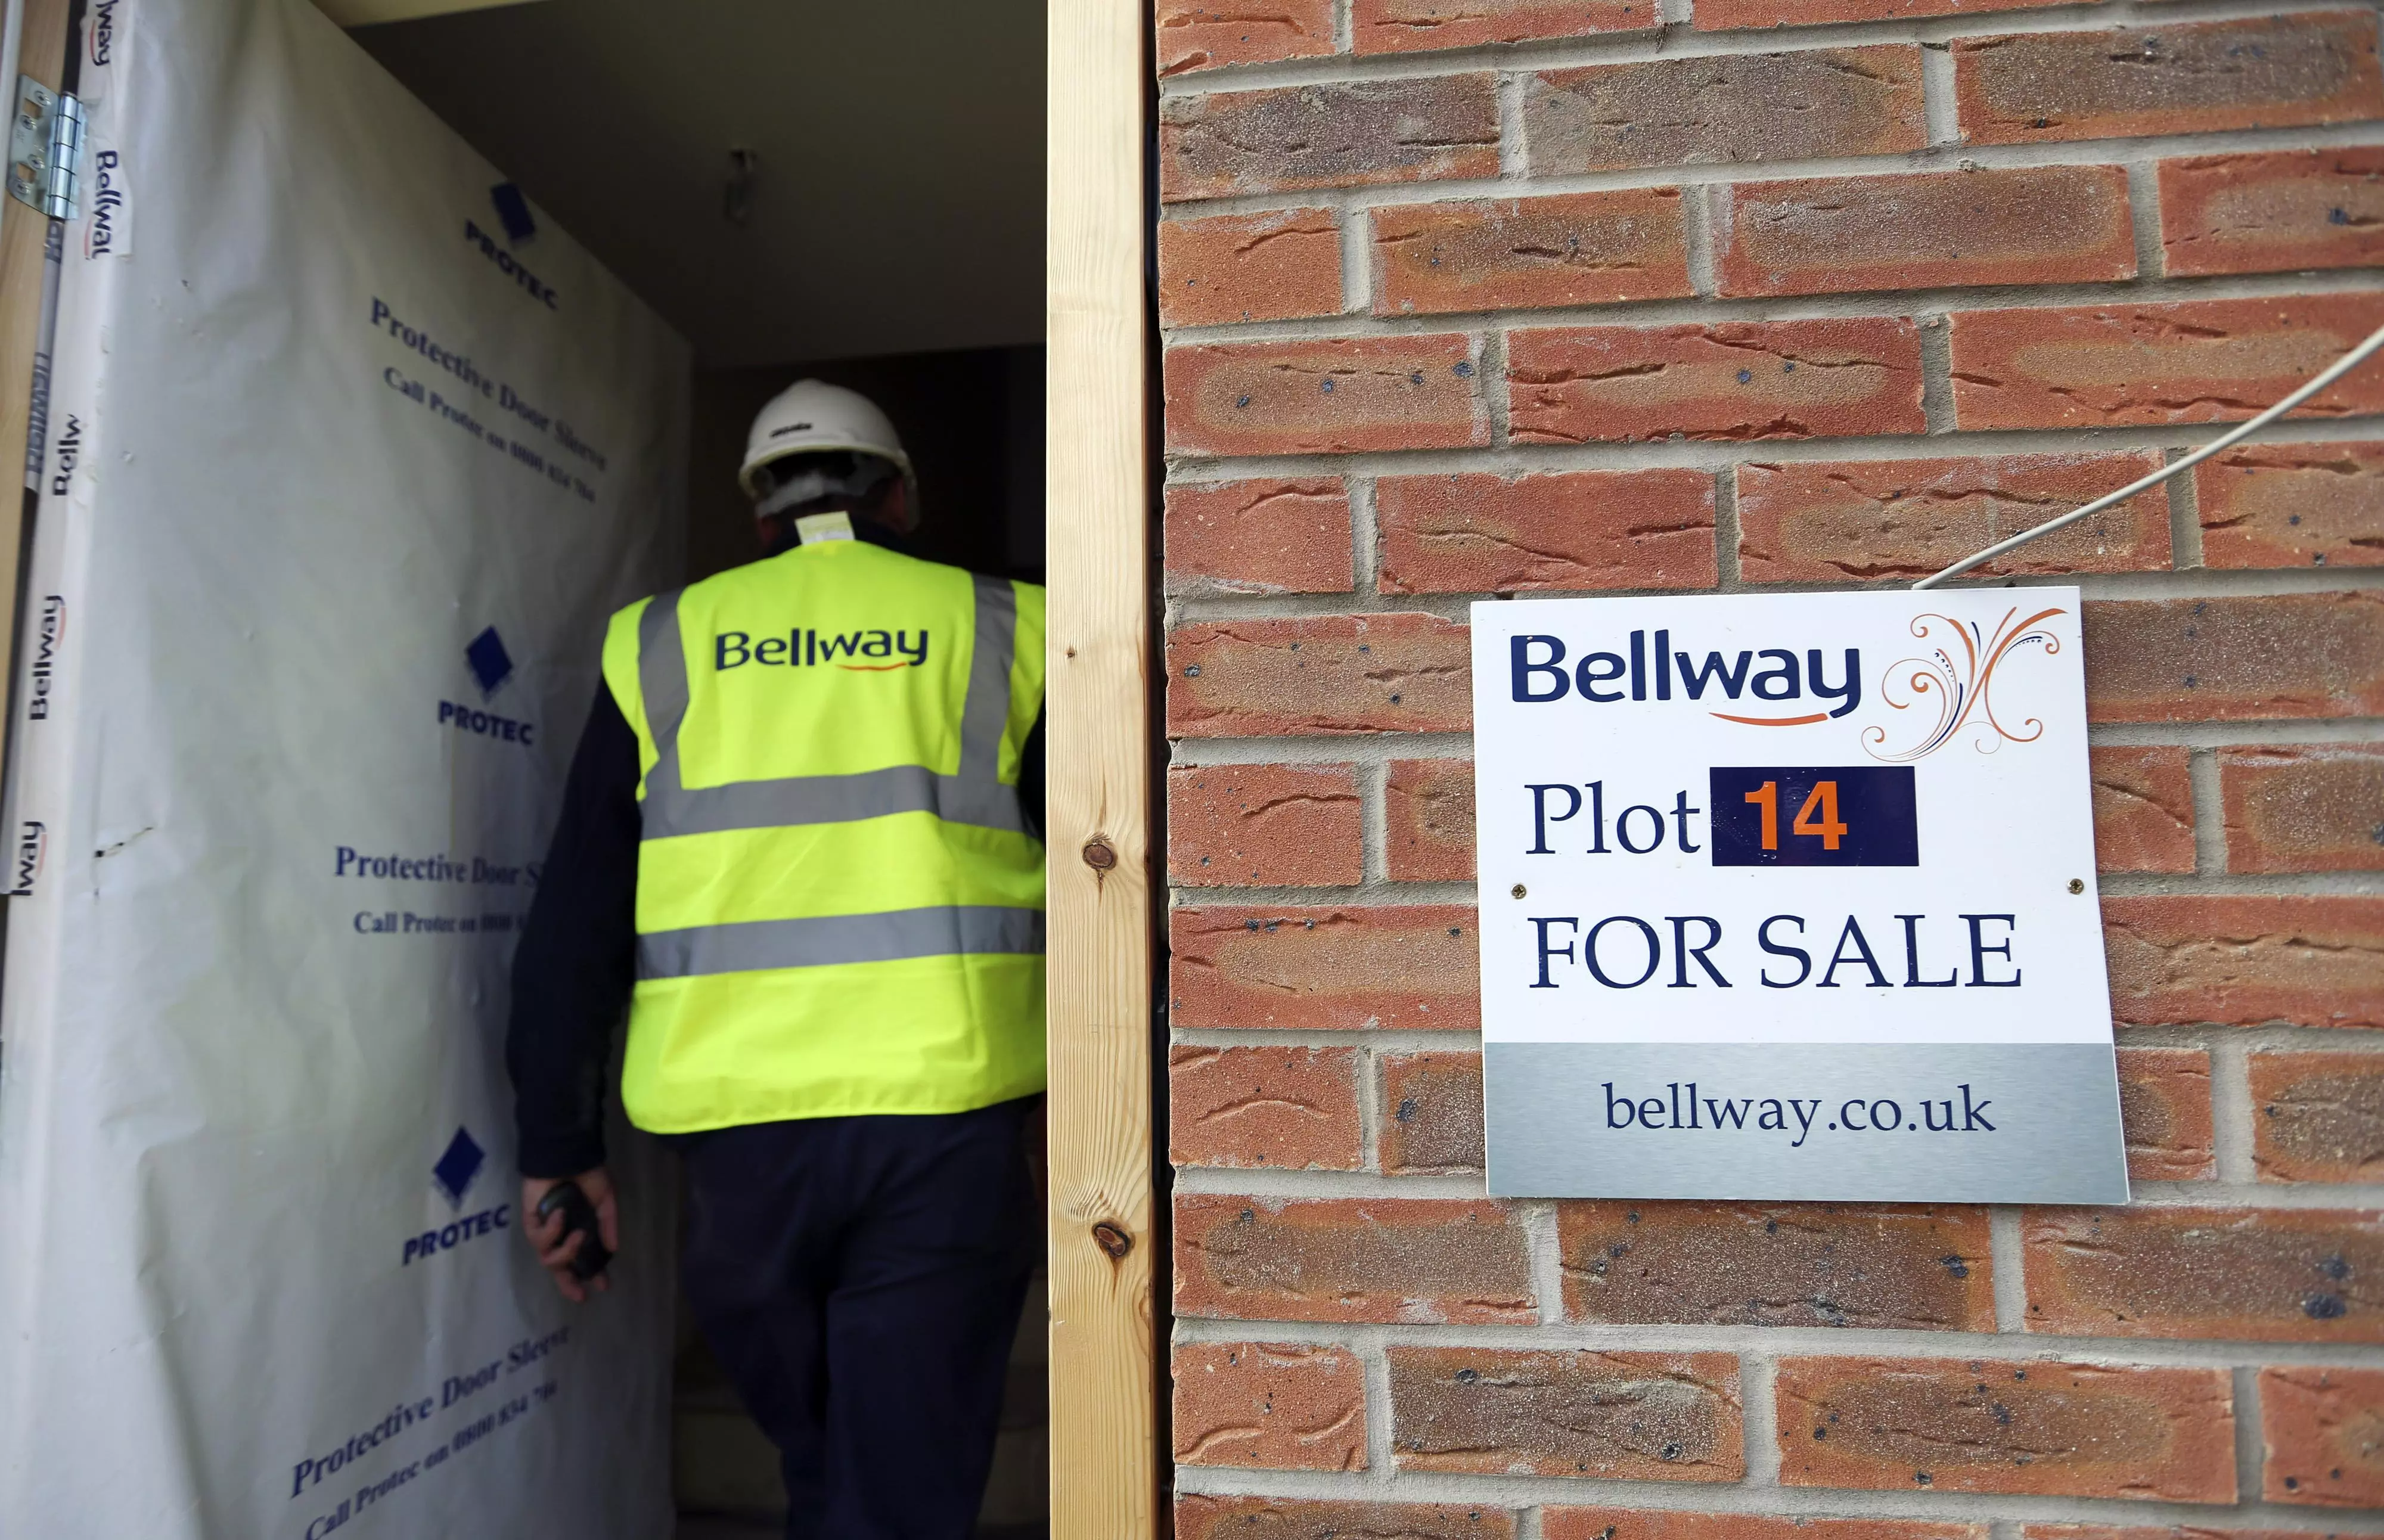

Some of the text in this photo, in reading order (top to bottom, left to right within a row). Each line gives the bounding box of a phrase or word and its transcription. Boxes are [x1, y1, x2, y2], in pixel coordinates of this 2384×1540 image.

[464, 218, 559, 312] PROTEC
[370, 296, 495, 399] Protective
[384, 367, 426, 405] Call
[29, 595, 65, 720] Bellway
[716, 628, 929, 672] Bellway
[1510, 629, 1862, 719] Bellway
[437, 700, 534, 746] PROTEC
[1524, 780, 1848, 855] Plot 14
[335, 845, 467, 883] Protective
[354, 911, 398, 934] Call
[1528, 913, 2022, 989] FOR SALE
[1600, 1082, 1997, 1148] bellway.co.uk
[401, 1203, 511, 1267] PROTEC
[290, 1395, 434, 1499] Protective
[440, 1359, 503, 1410] Door
[305, 1497, 350, 1540] Call
[355, 1460, 420, 1516] Protec
[424, 1439, 449, 1470] on
